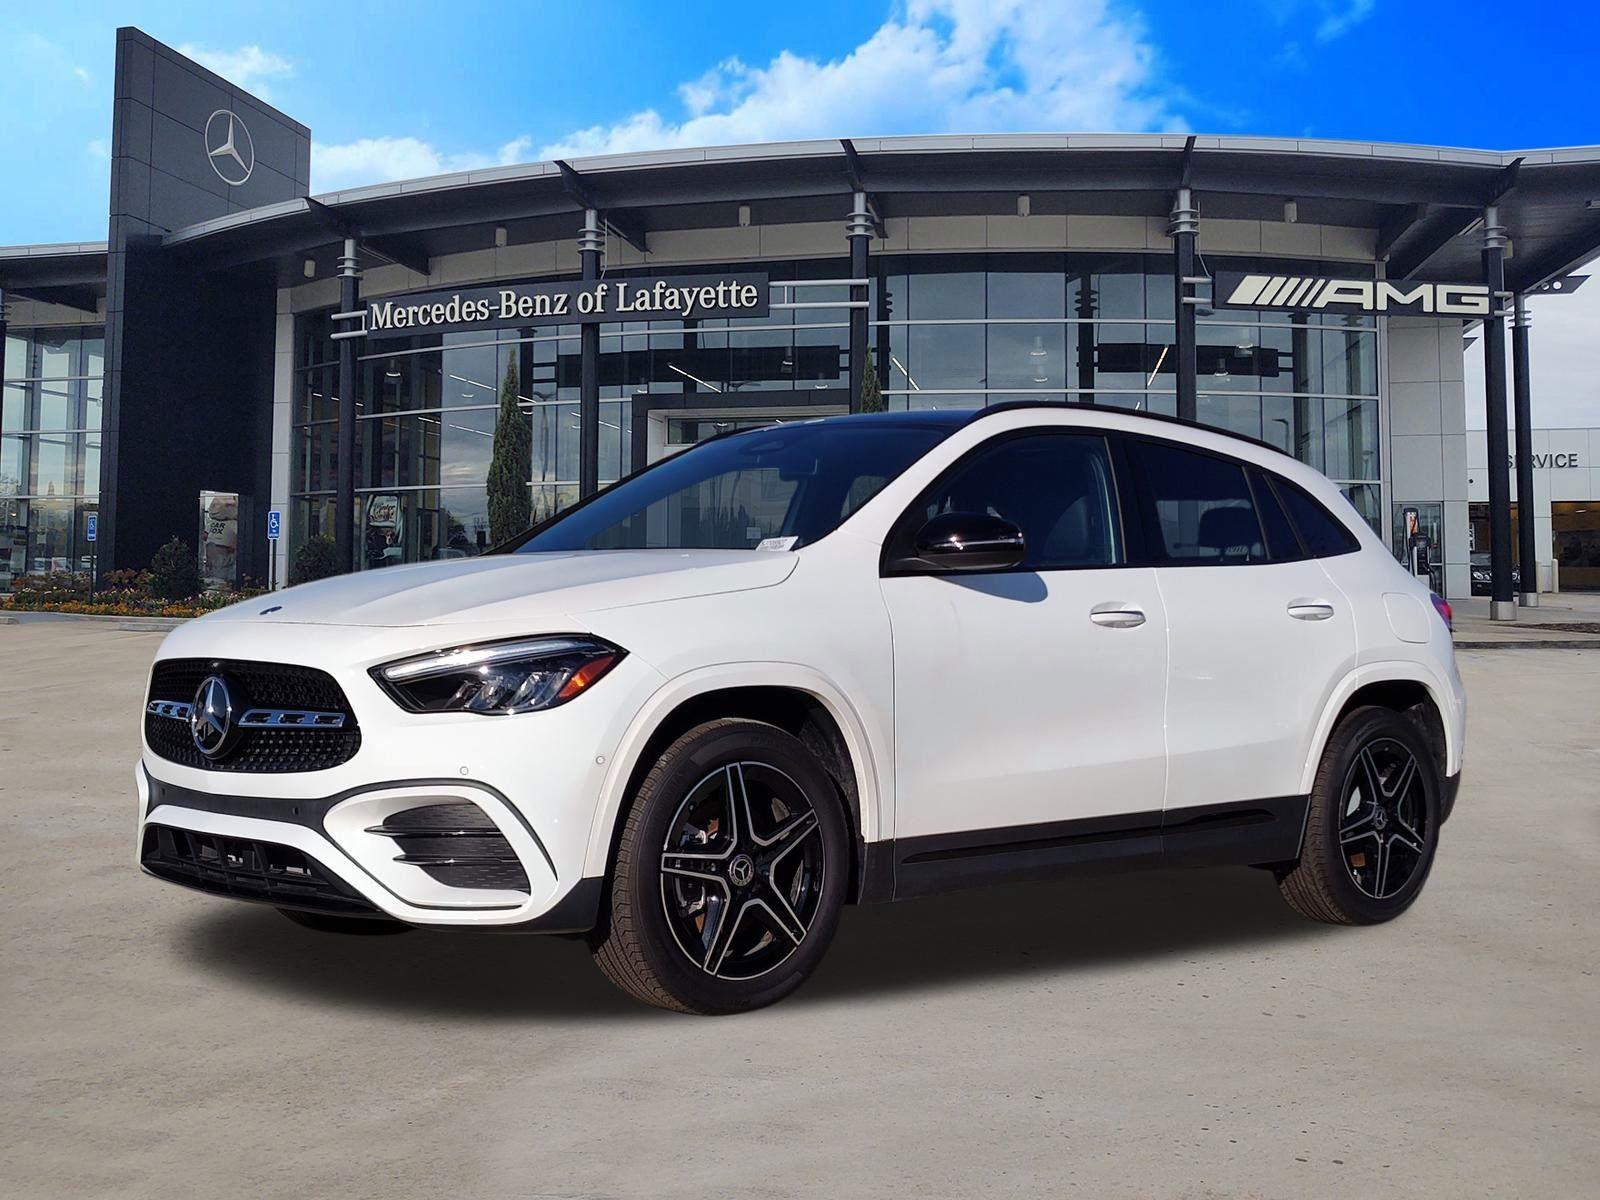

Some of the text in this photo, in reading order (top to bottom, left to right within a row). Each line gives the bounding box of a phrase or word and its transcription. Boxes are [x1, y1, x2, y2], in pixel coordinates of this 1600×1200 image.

[370, 280, 758, 331] Mercedes-Benz of Lafayette
[1312, 279, 1489, 315] AMG
